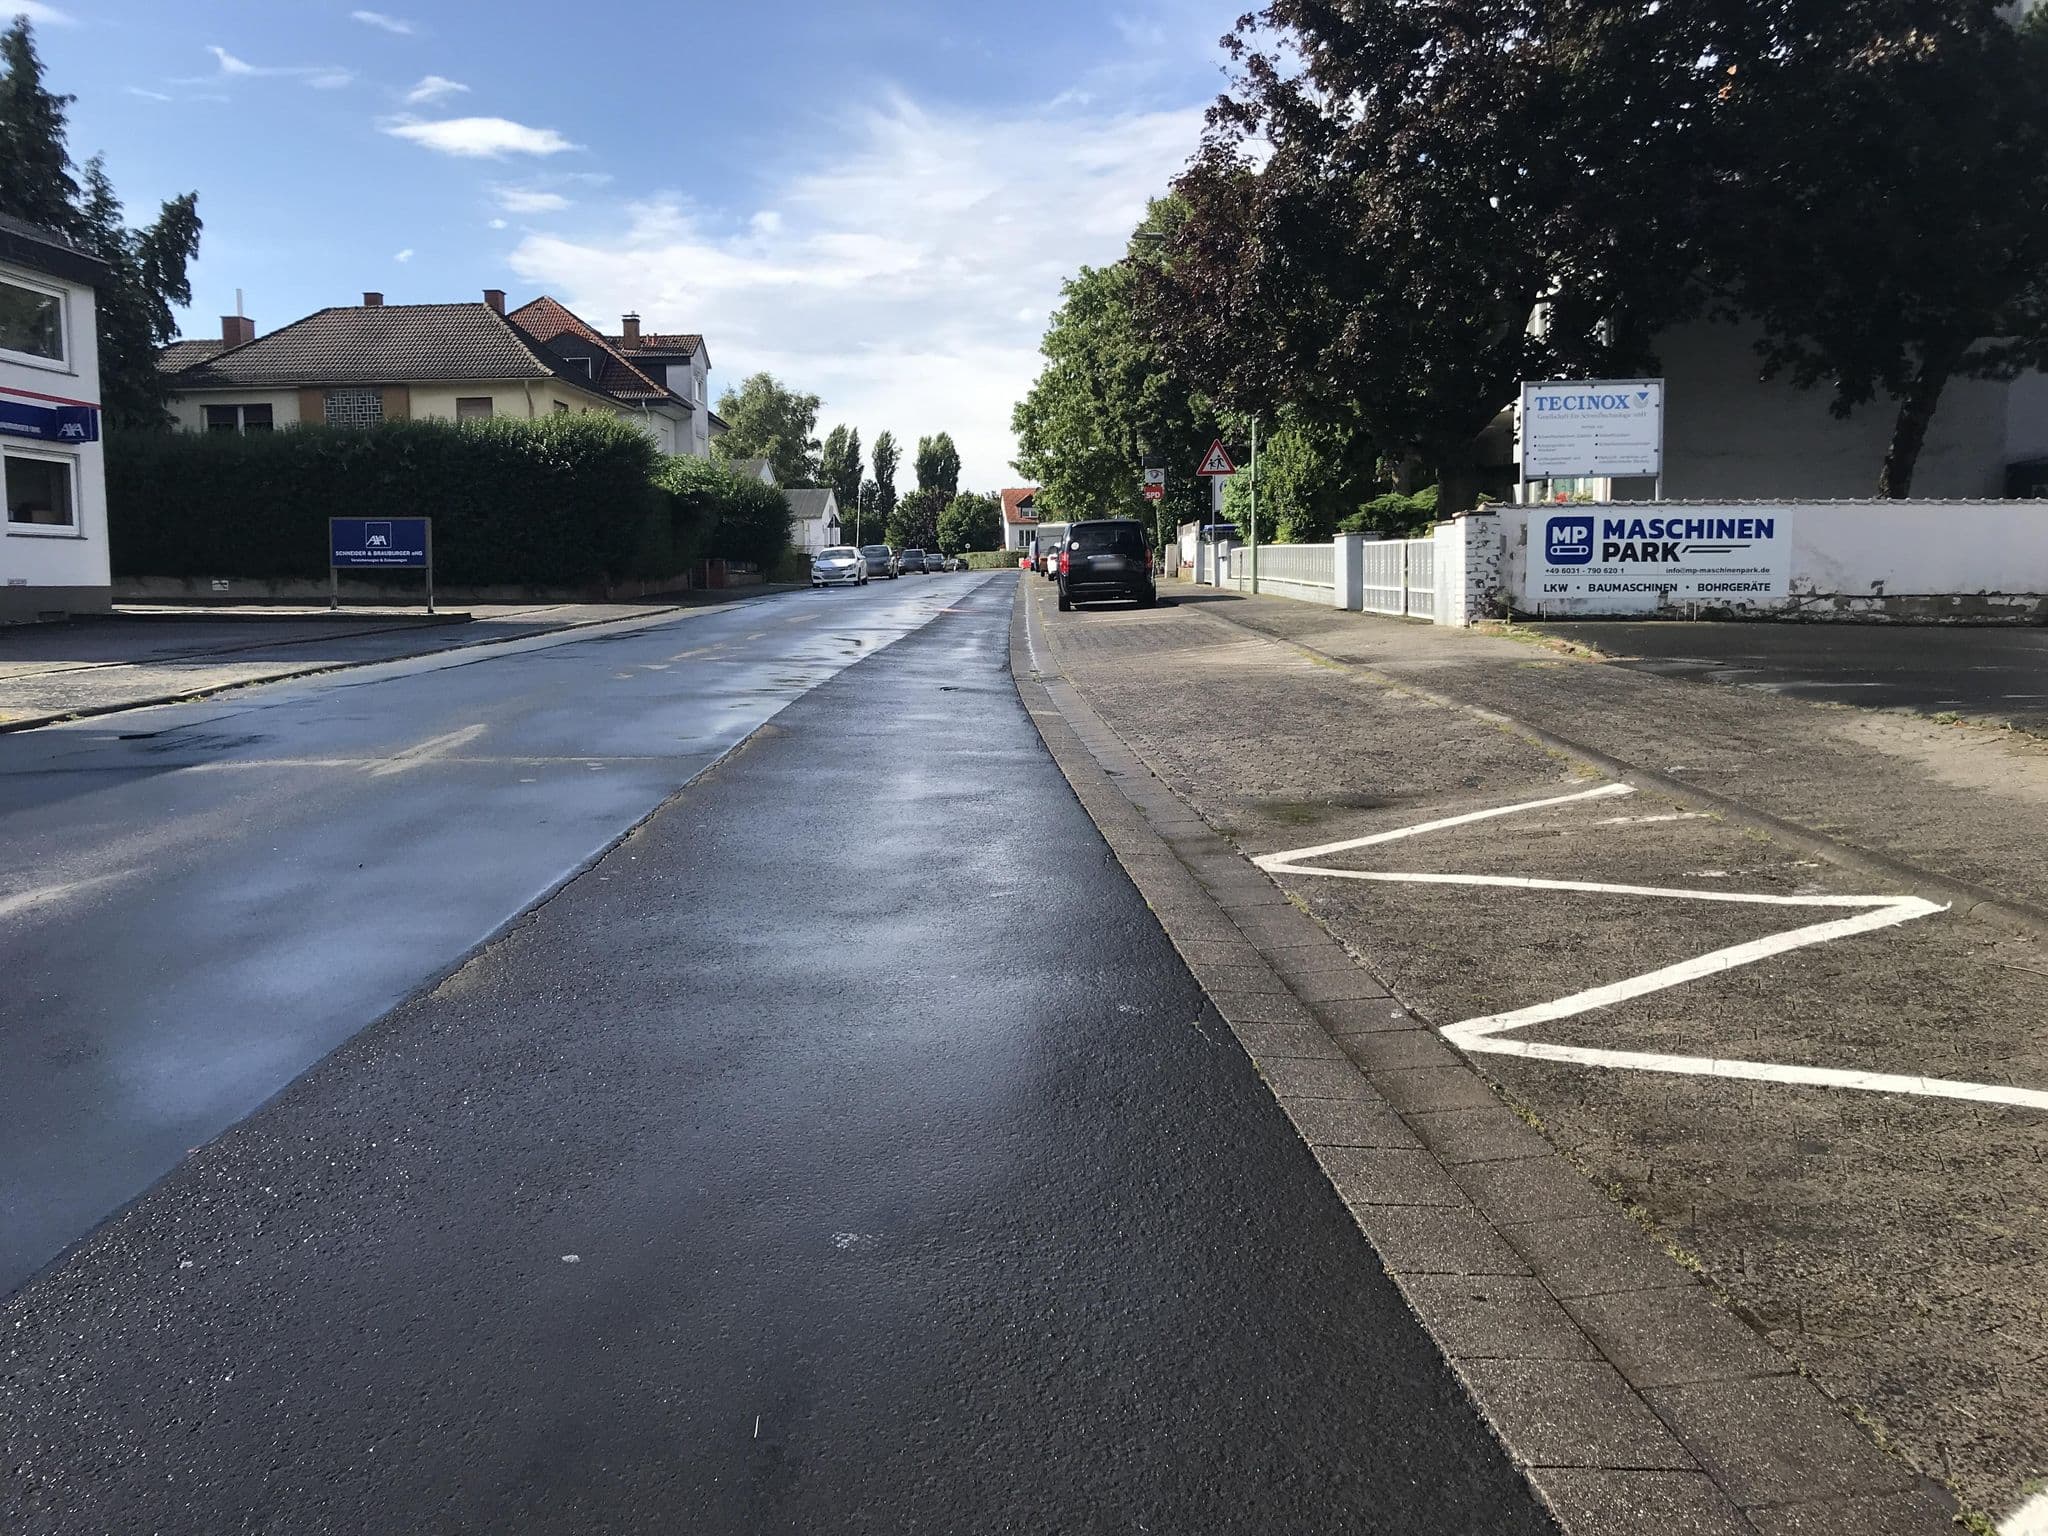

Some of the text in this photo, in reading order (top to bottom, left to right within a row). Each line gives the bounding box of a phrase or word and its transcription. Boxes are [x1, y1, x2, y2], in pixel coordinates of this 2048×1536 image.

[1535, 394, 1630, 411] TECINOX
[57, 423, 85, 437] AXA
[1145, 491, 1161, 499] SPD
[1552, 526, 1588, 544] MP
[1603, 518, 1774, 540] MASCHINEN
[366, 535, 387, 546] AXA
[1602, 542, 1680, 562] PARK
[1665, 566, 1770, 575] info@mp-maschinenpark.de
[1543, 580, 1771, 592] LKW BAUMASCHINEN BOHRGERÄTE
